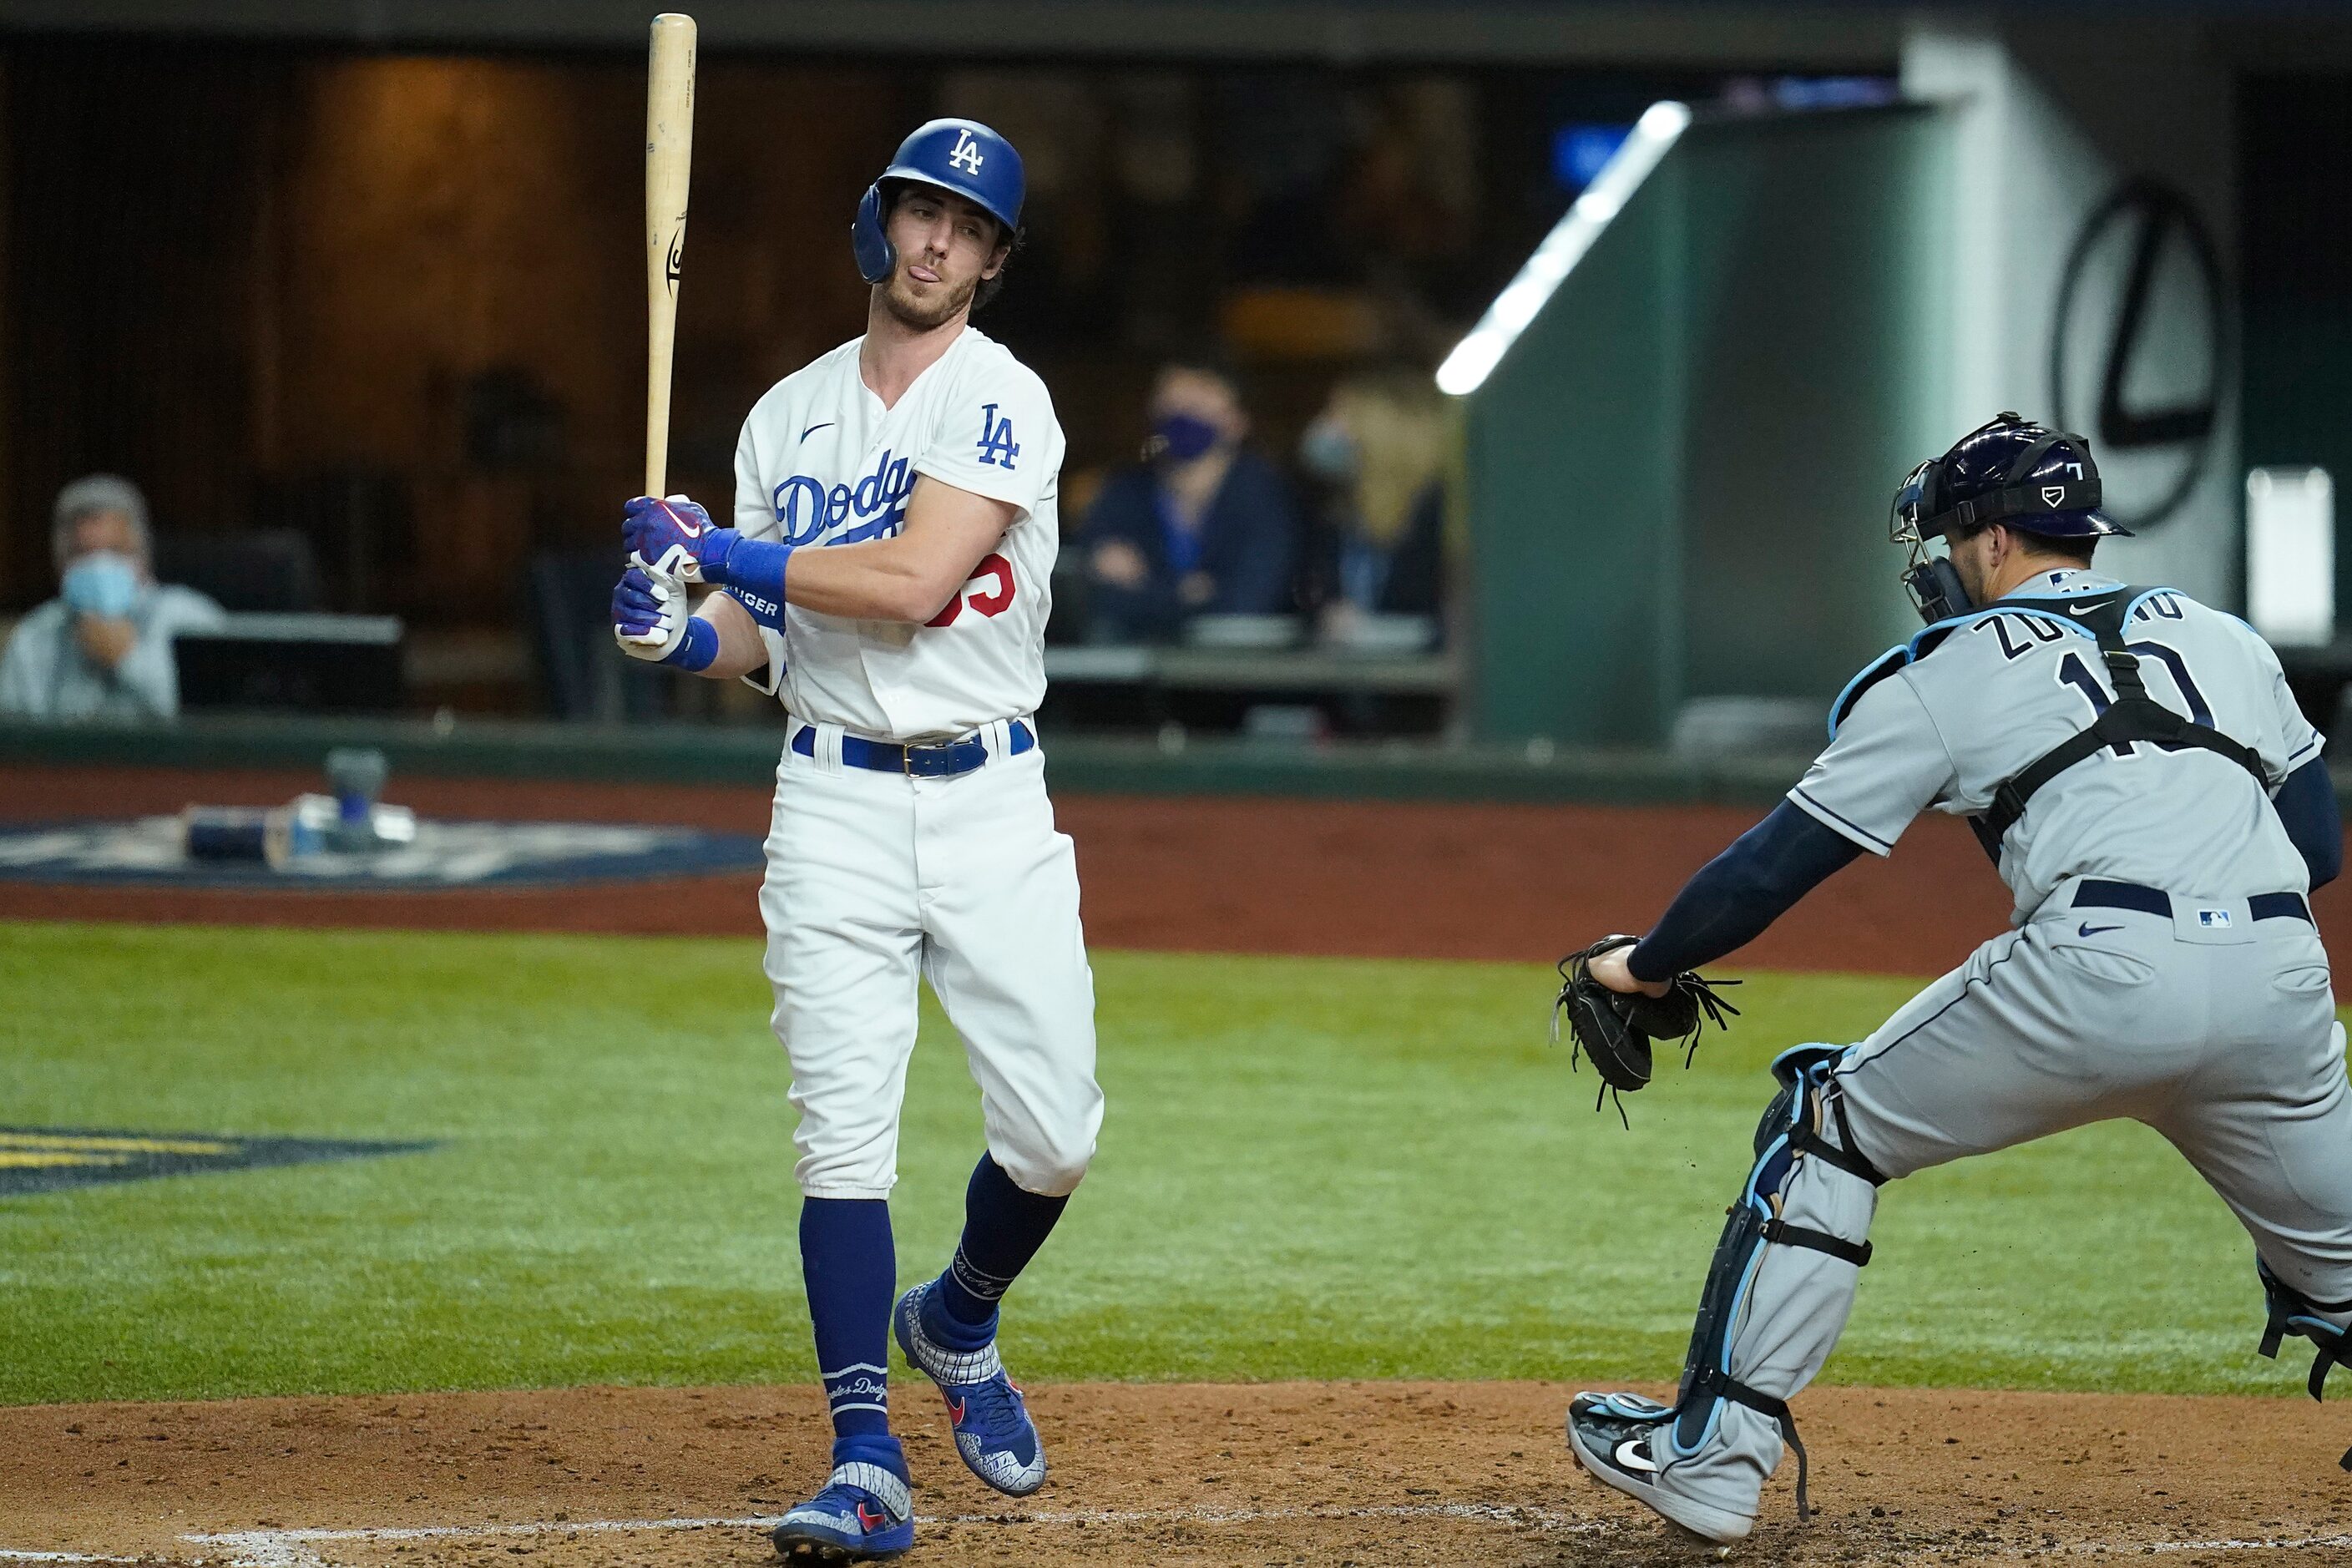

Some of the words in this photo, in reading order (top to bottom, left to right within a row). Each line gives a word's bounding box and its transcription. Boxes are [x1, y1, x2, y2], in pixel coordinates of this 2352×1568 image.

[949, 129, 984, 175] LA
[977, 403, 1020, 470] LA
[774, 448, 918, 546] Dodg
[923, 552, 1016, 627] 5
[2054, 639, 2218, 761] 10
